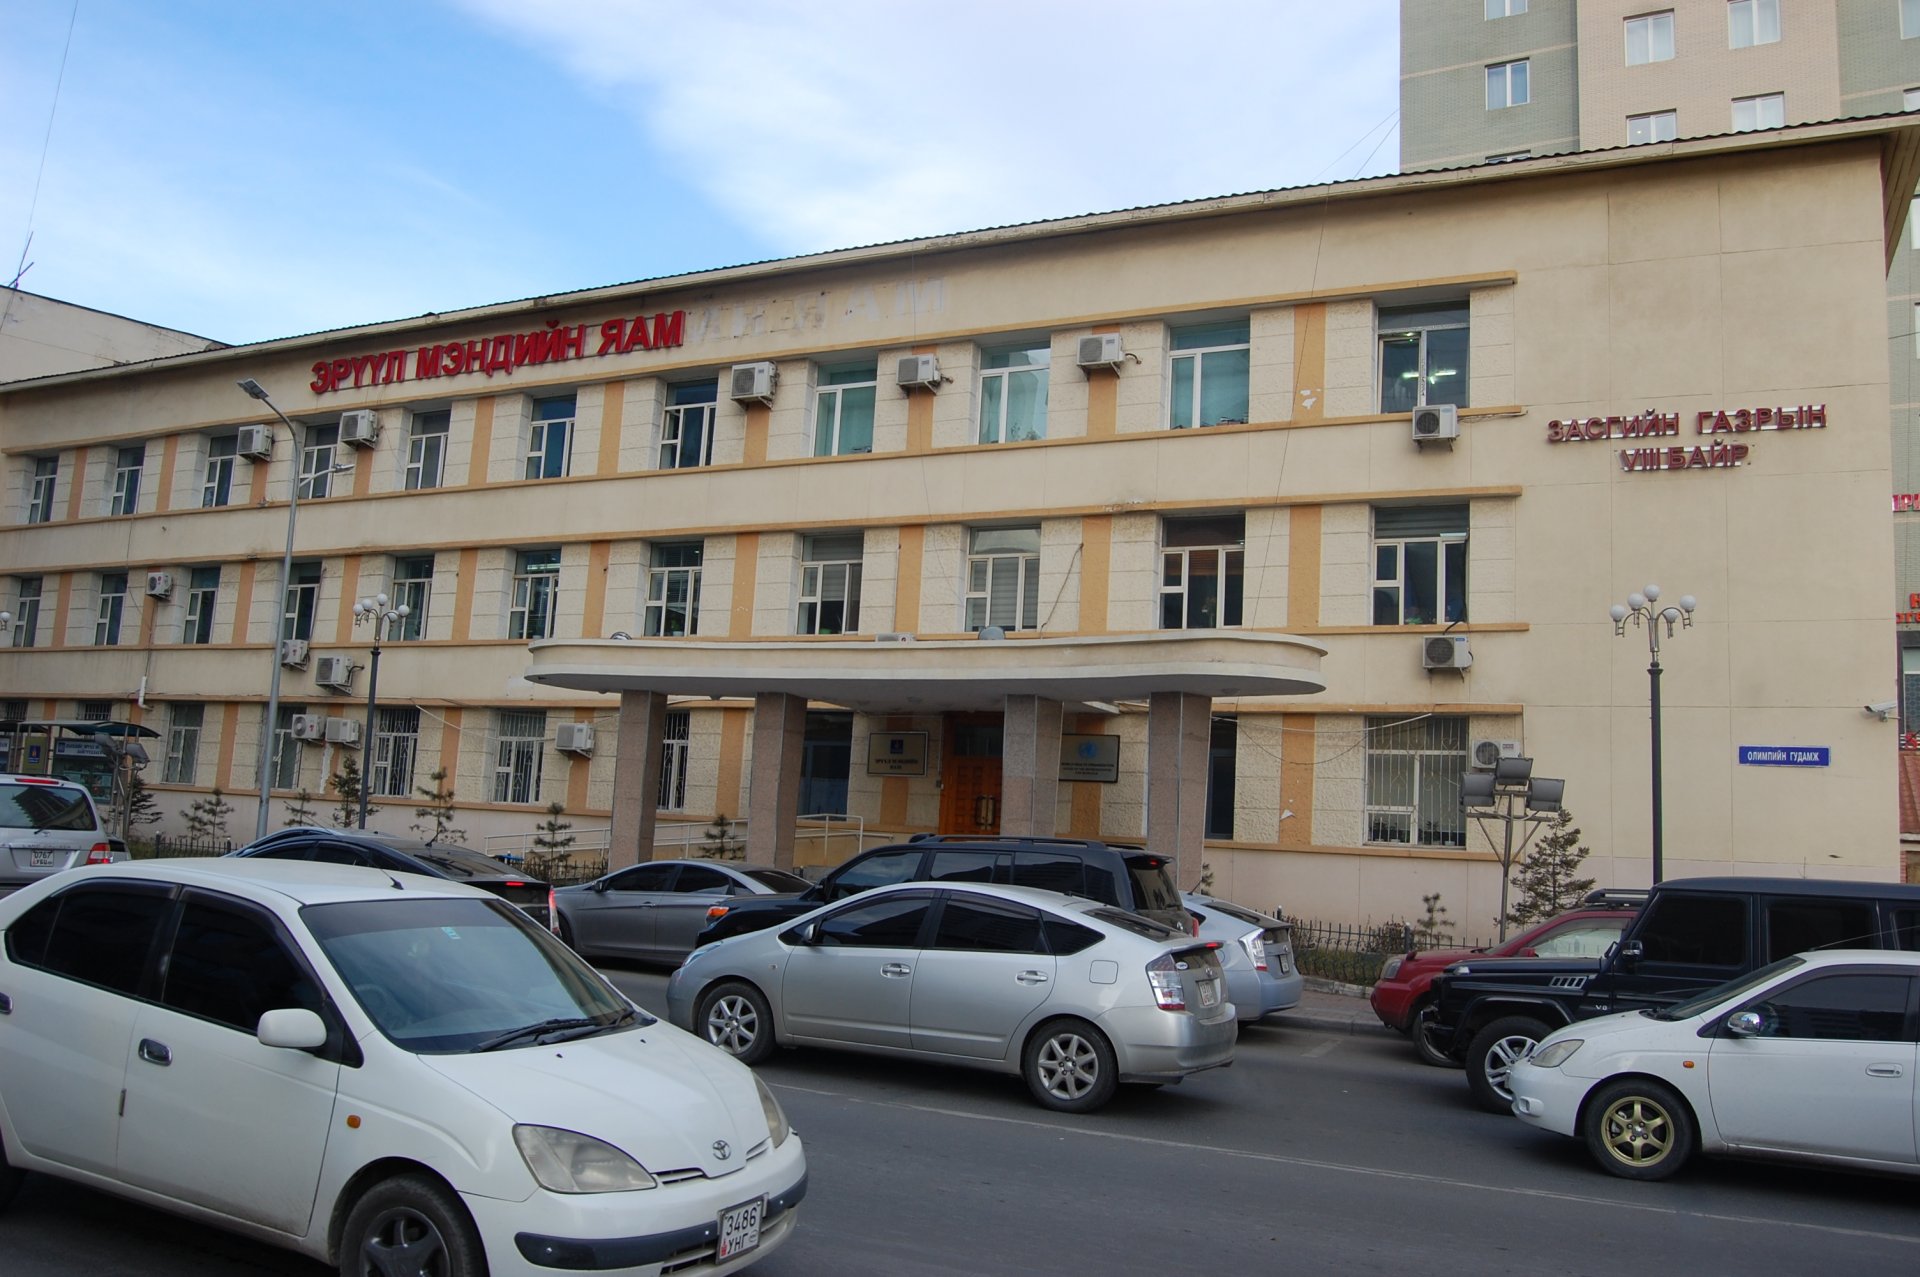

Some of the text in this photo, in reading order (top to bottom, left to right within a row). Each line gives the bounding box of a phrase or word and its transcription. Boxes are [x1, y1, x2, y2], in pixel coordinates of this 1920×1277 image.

[310, 350, 407, 394] ЭРҮҮЛ
[415, 320, 587, 377] МЭНДИЙН
[597, 310, 686, 356] ЯАМ
[1548, 404, 1827, 442] ЗАСГИЙН ГАЗРЫН
[1668, 439, 1749, 469] БАЙР
[1747, 750, 1820, 763] ОЛИМПИЙН ГУДАМЖ
[726, 1206, 758, 1236] 3486
[727, 1232, 749, 1254] УНГ
